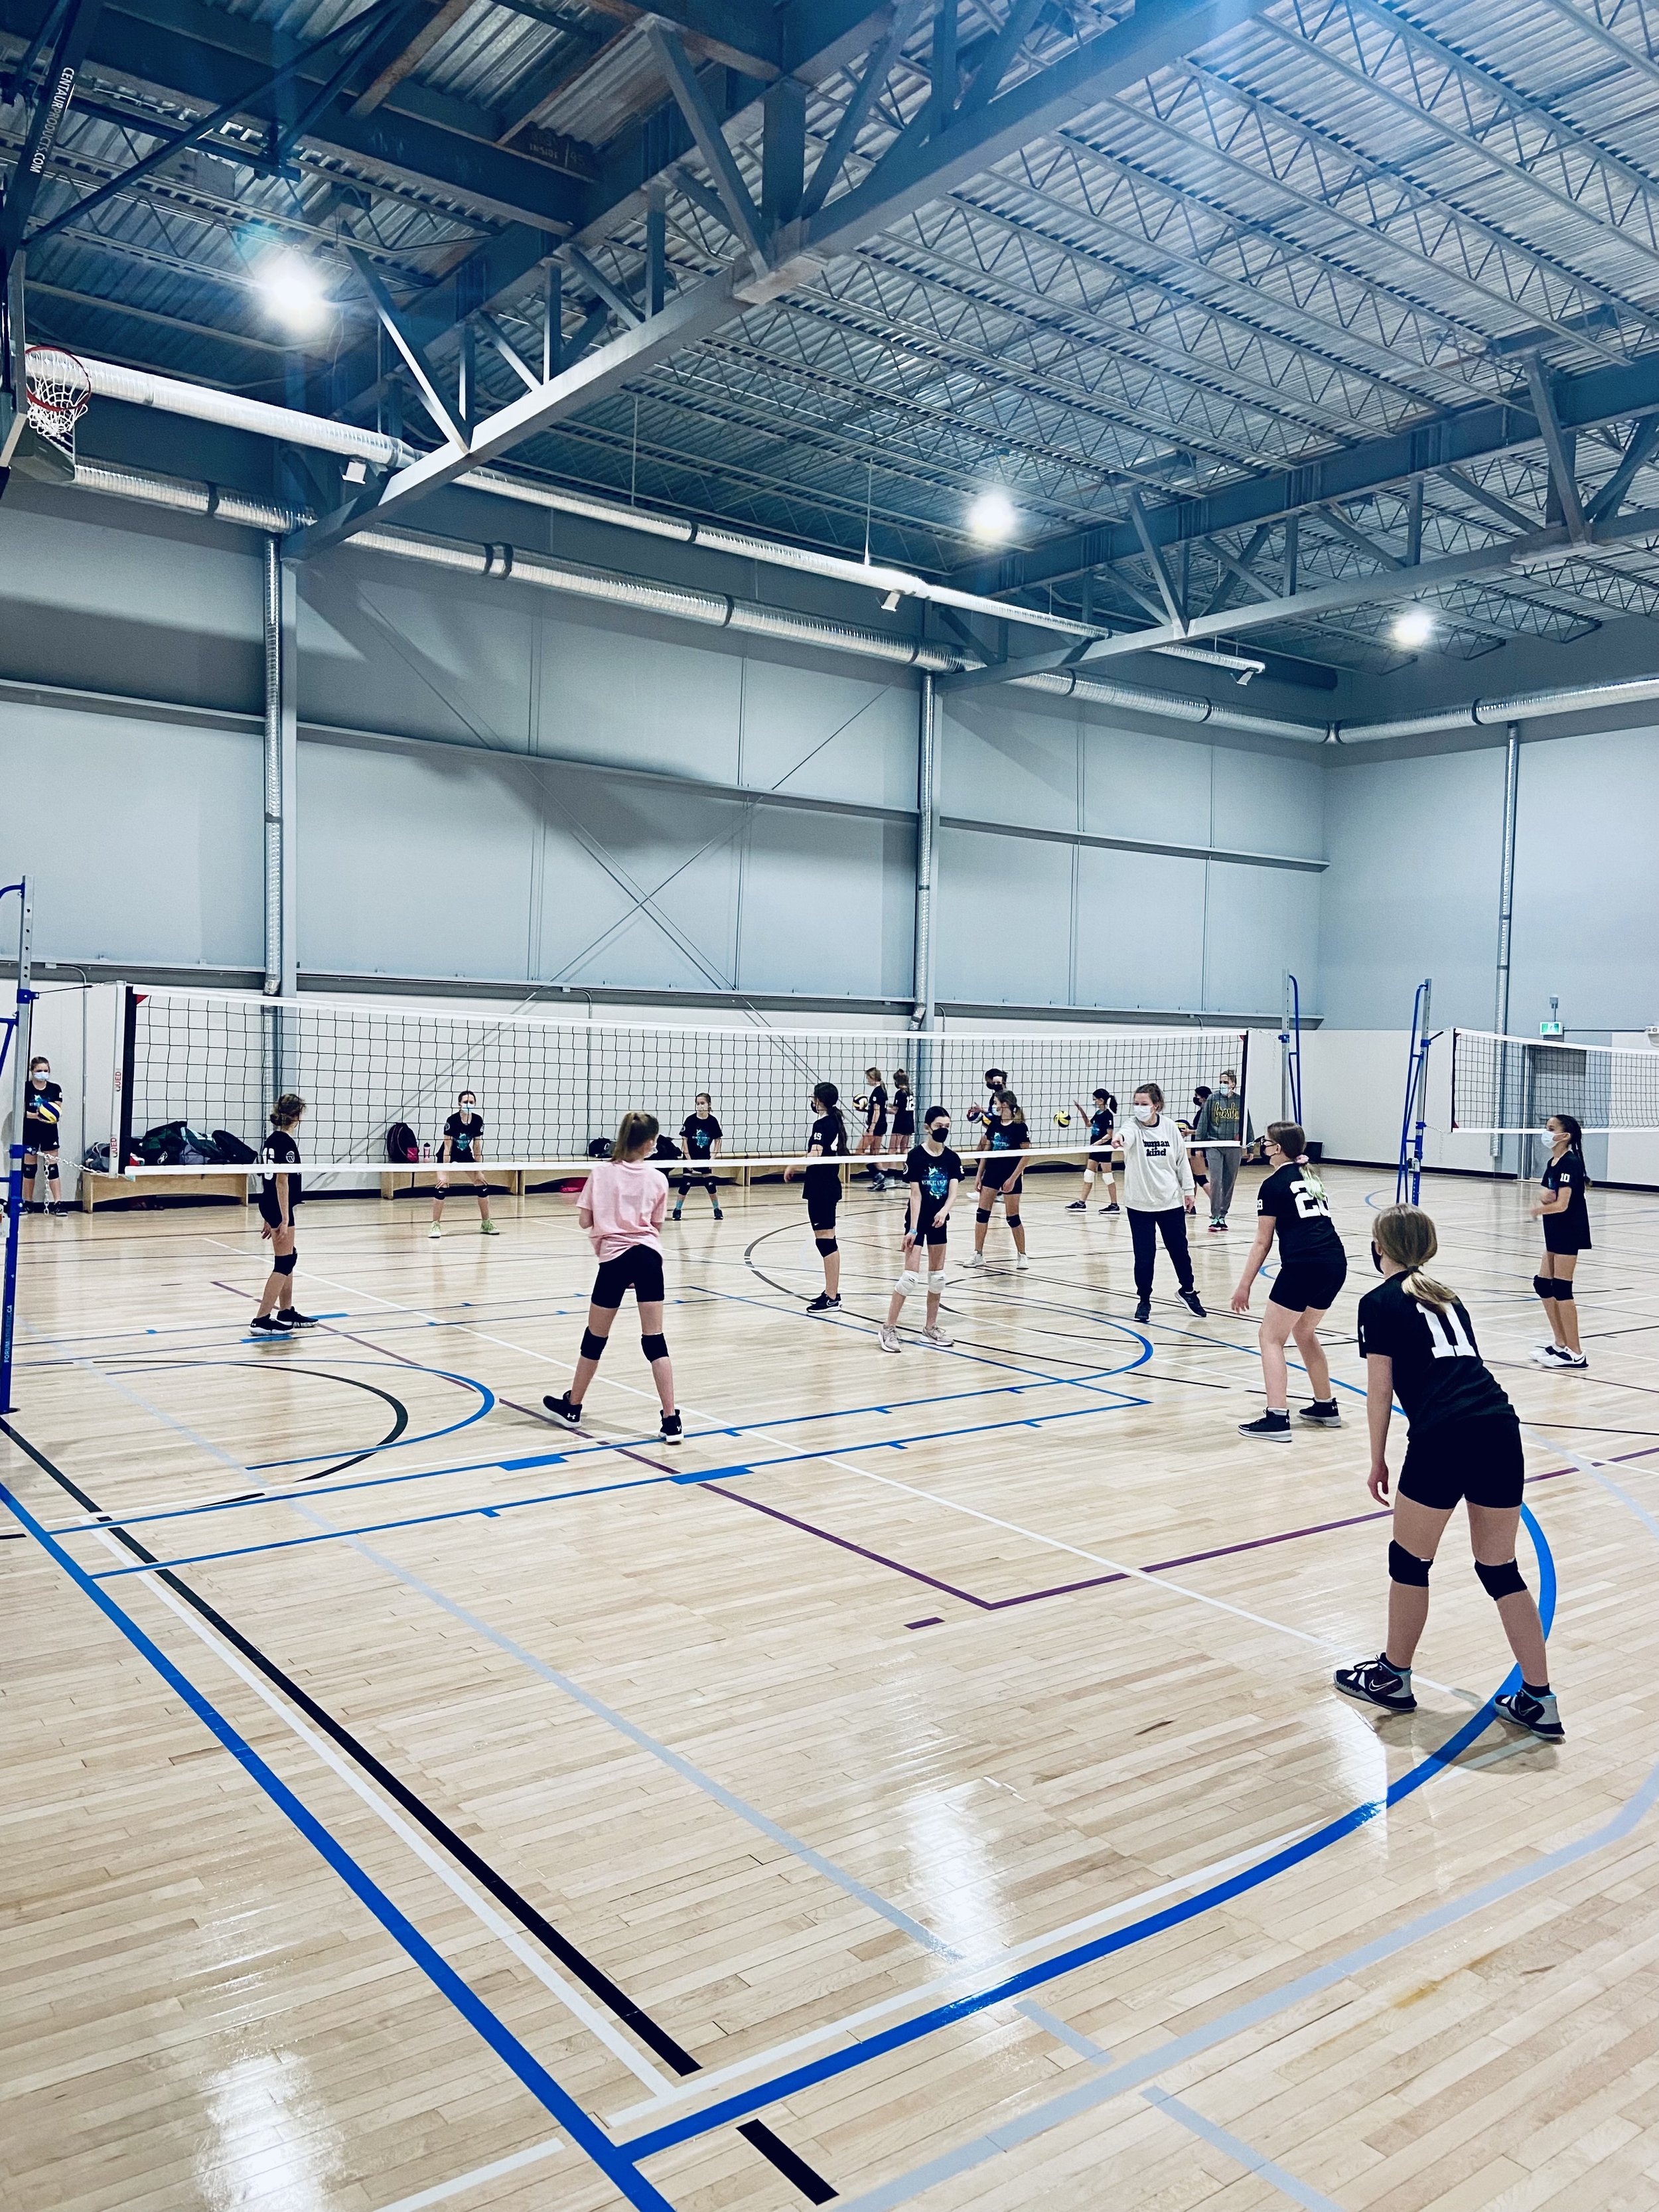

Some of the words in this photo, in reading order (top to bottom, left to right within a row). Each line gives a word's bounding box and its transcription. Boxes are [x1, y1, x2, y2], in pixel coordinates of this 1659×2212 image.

[30, 67, 74, 173] CENTAURPRODUCTS.COM
[1147, 1148, 1166, 1157] kind
[1560, 1173, 1570, 1183] 10
[1416, 1302, 1477, 1359] 11
